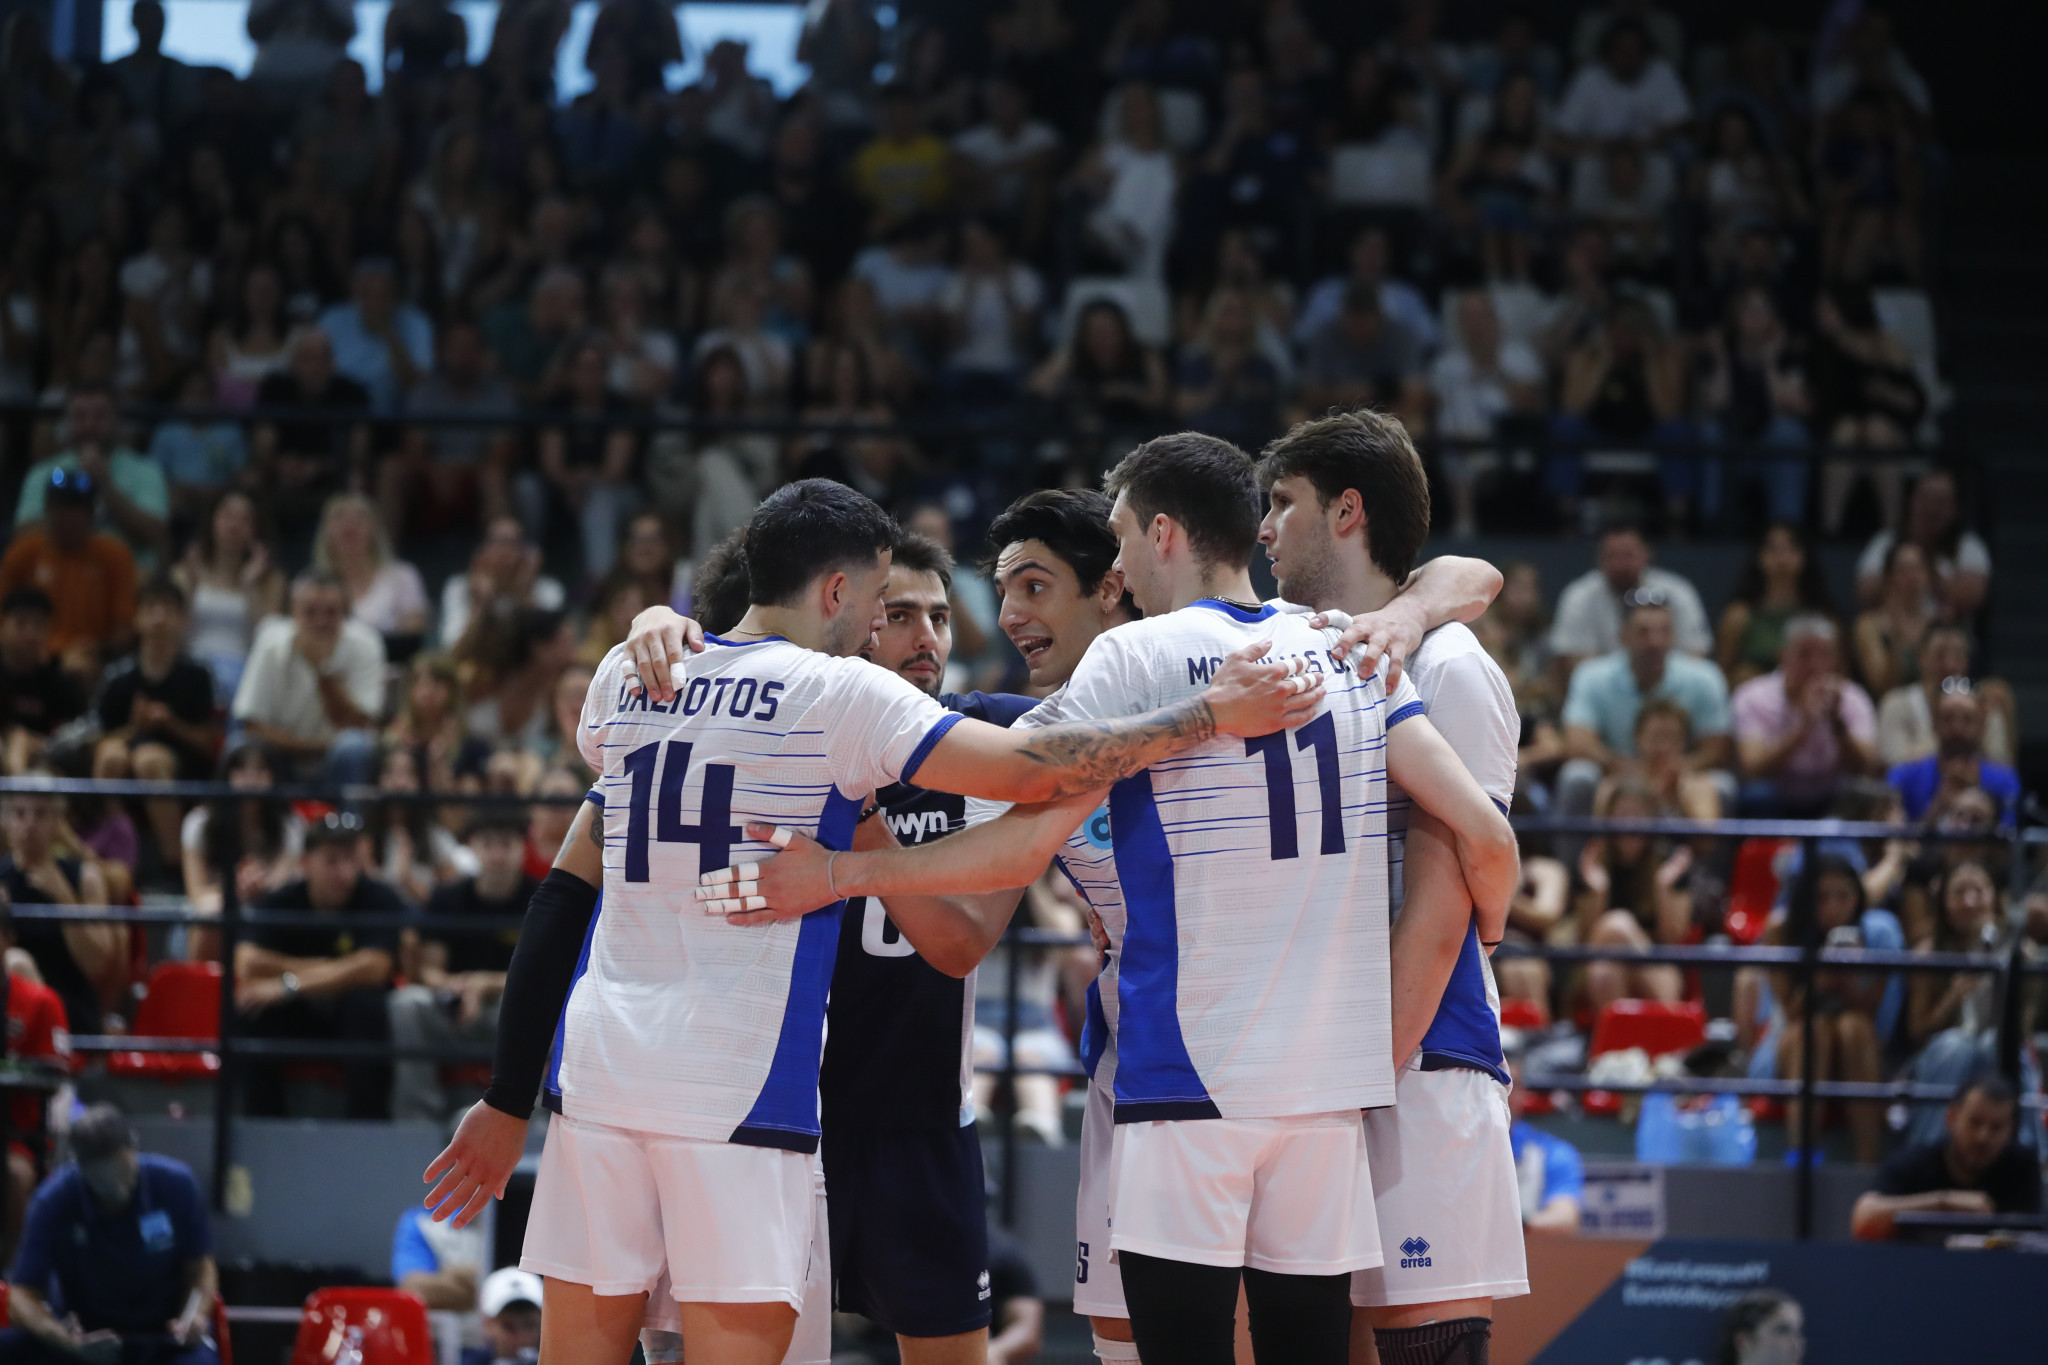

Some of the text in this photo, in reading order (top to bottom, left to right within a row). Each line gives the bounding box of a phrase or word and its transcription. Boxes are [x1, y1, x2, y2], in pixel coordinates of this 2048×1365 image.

[623, 740, 743, 884] 14
[1244, 710, 1347, 861] 11
[1400, 1256, 1432, 1269] errea
